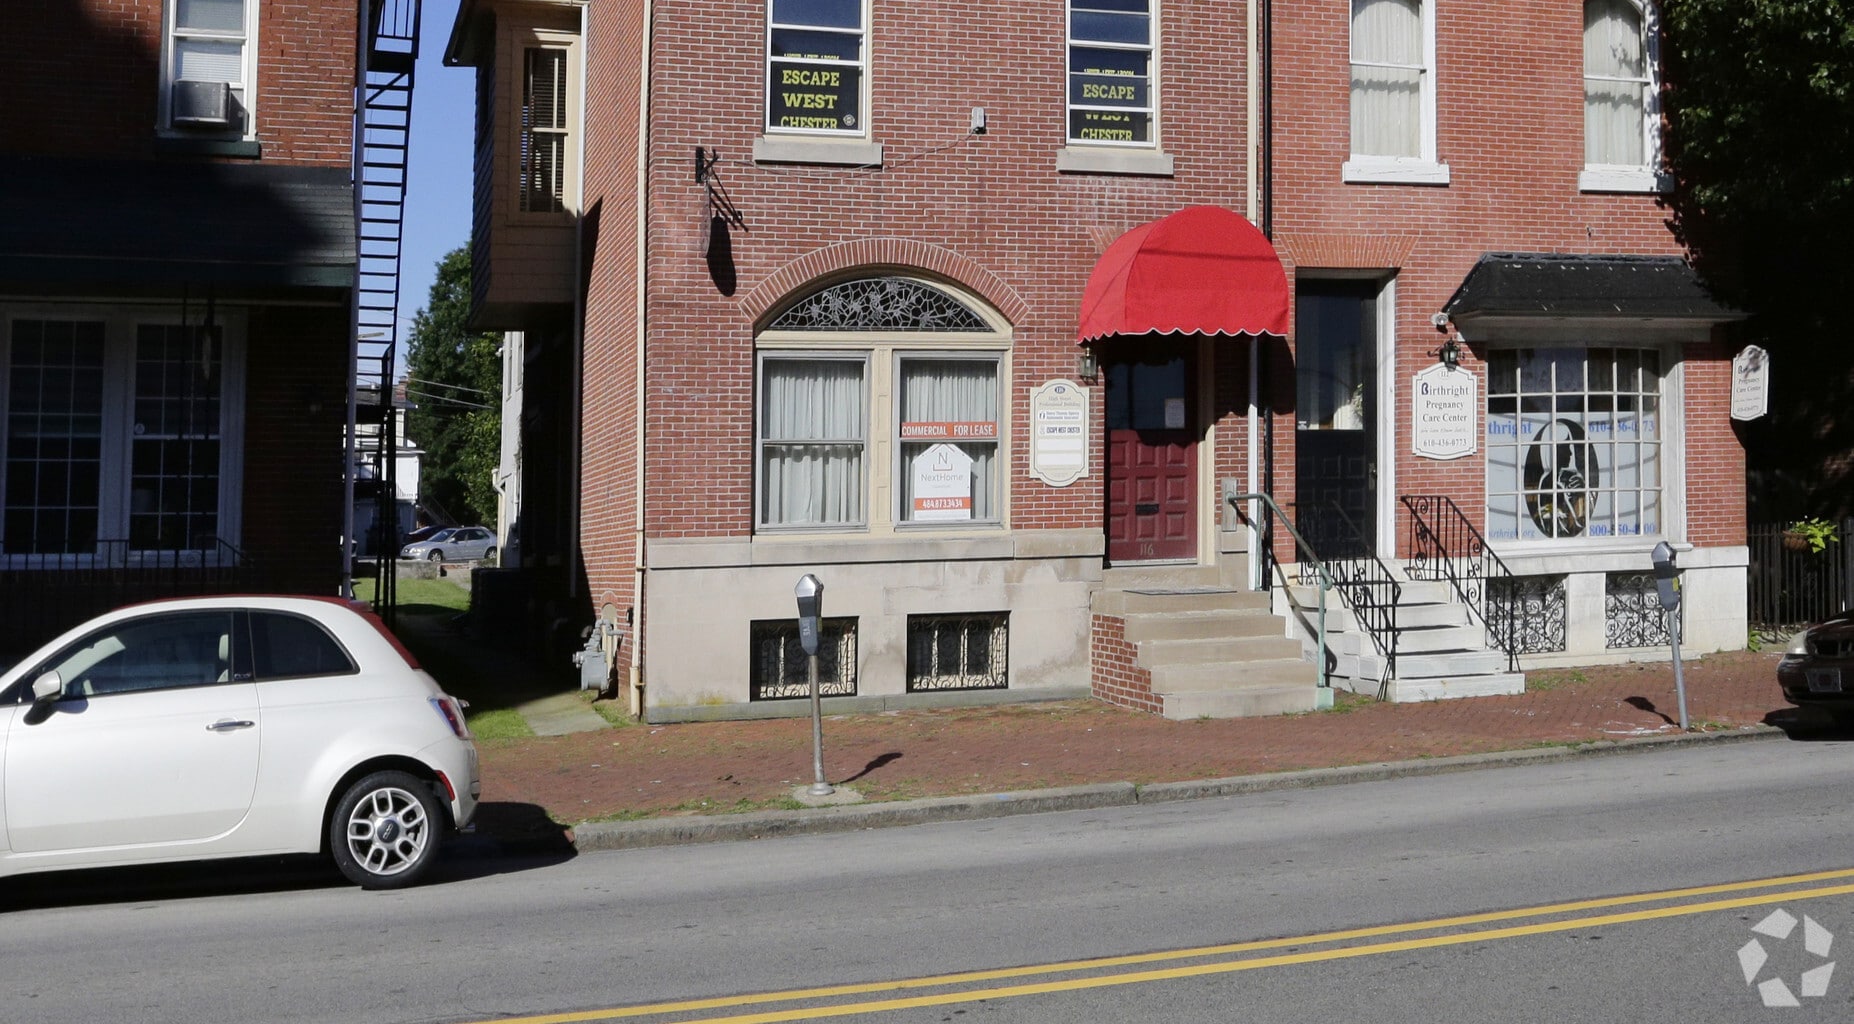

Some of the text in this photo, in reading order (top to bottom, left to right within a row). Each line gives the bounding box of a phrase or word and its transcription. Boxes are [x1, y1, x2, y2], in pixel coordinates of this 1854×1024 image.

[782, 70, 839, 86] ESCAPE
[1083, 84, 1134, 100] ESCAPE
[782, 93, 837, 109] WEST
[780, 116, 838, 129] CHESTER
[1081, 128, 1133, 141] CHESTER
[1421, 382, 1469, 396] Birthright
[1425, 400, 1464, 410] Pregnancy
[1422, 413, 1467, 422] Care Center
[901, 425, 993, 436] COMMERCIAL FOR LEASE
[1423, 438, 1467, 447] 610-436-0773
[920, 473, 964, 482] NextHome
[1140, 543, 1154, 556] 116
